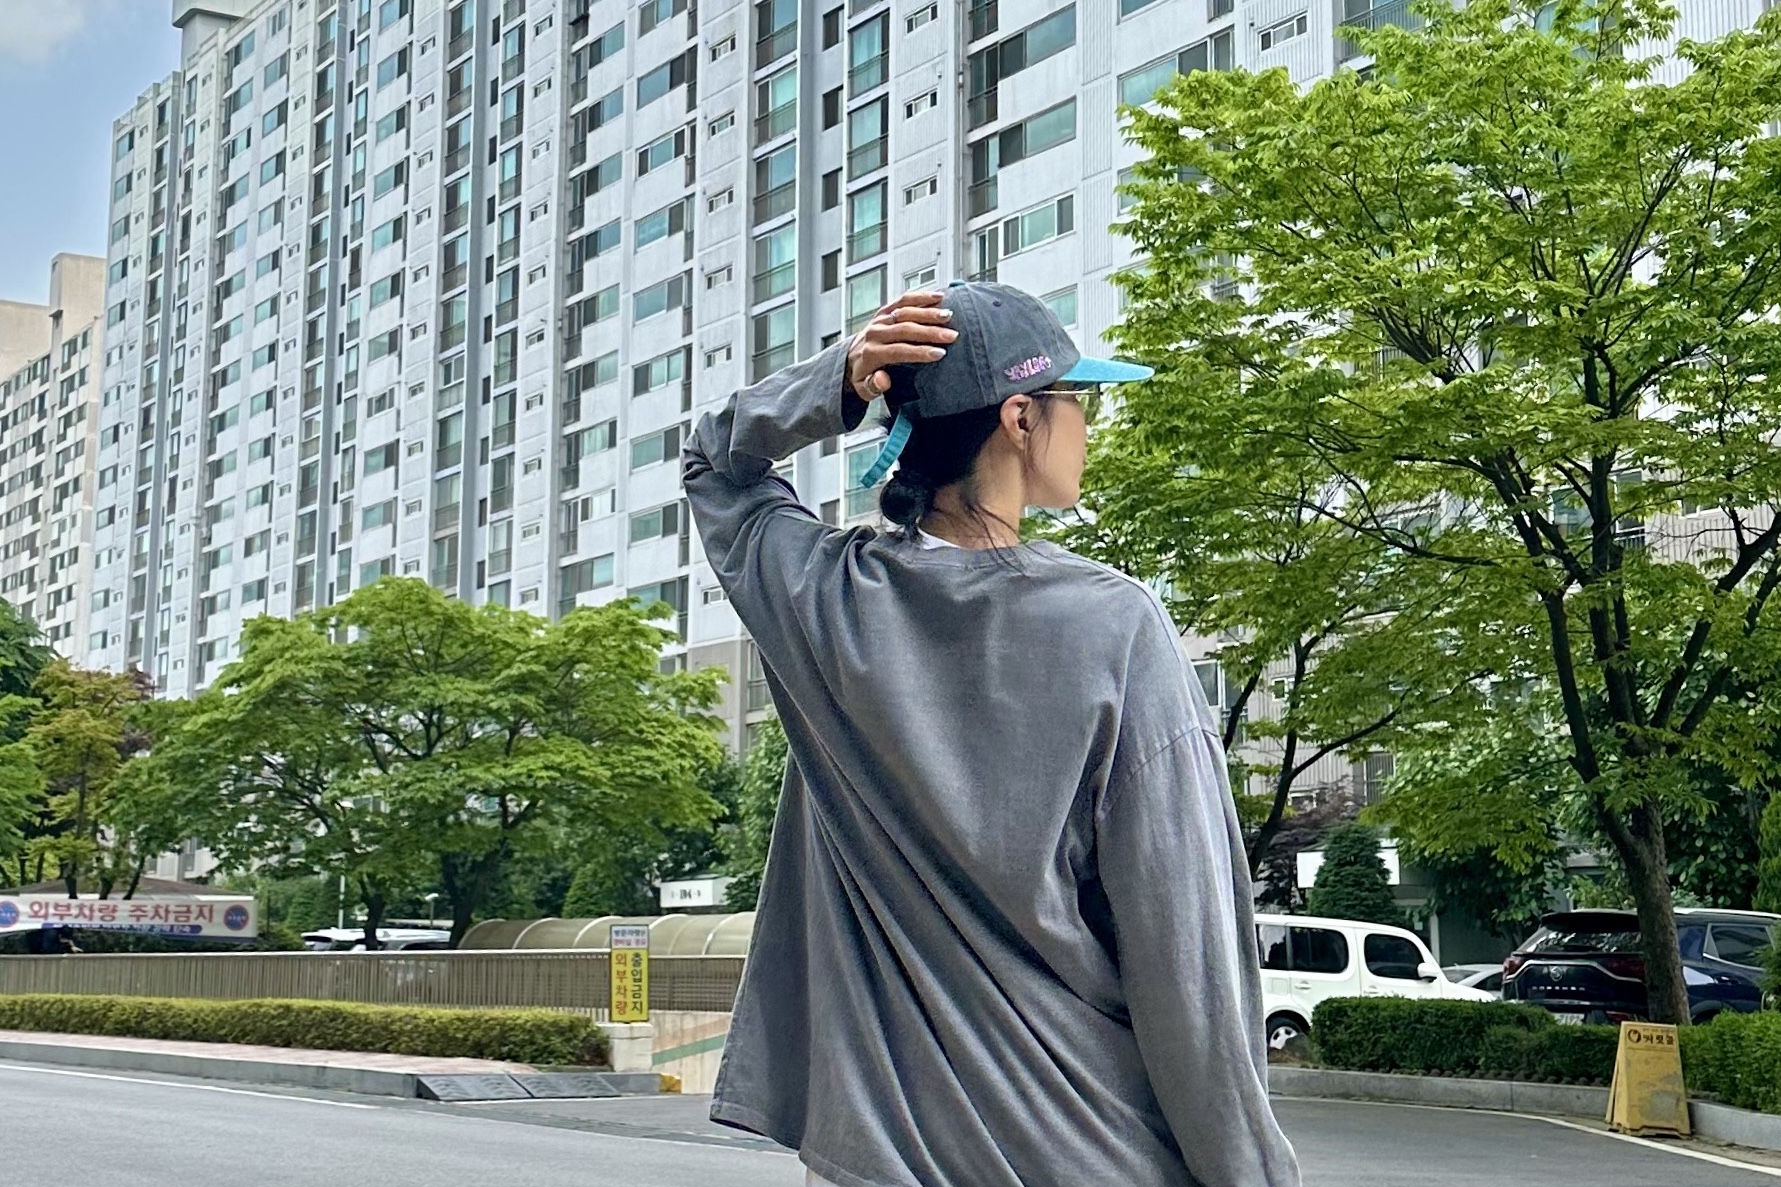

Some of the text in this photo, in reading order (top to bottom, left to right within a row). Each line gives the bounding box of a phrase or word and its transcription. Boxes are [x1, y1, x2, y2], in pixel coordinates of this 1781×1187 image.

[28, 901, 118, 922] 외부차량
[128, 903, 215, 923] 주차금지
[615, 952, 628, 1016] 외부차량
[630, 952, 643, 1014] 출입금지
